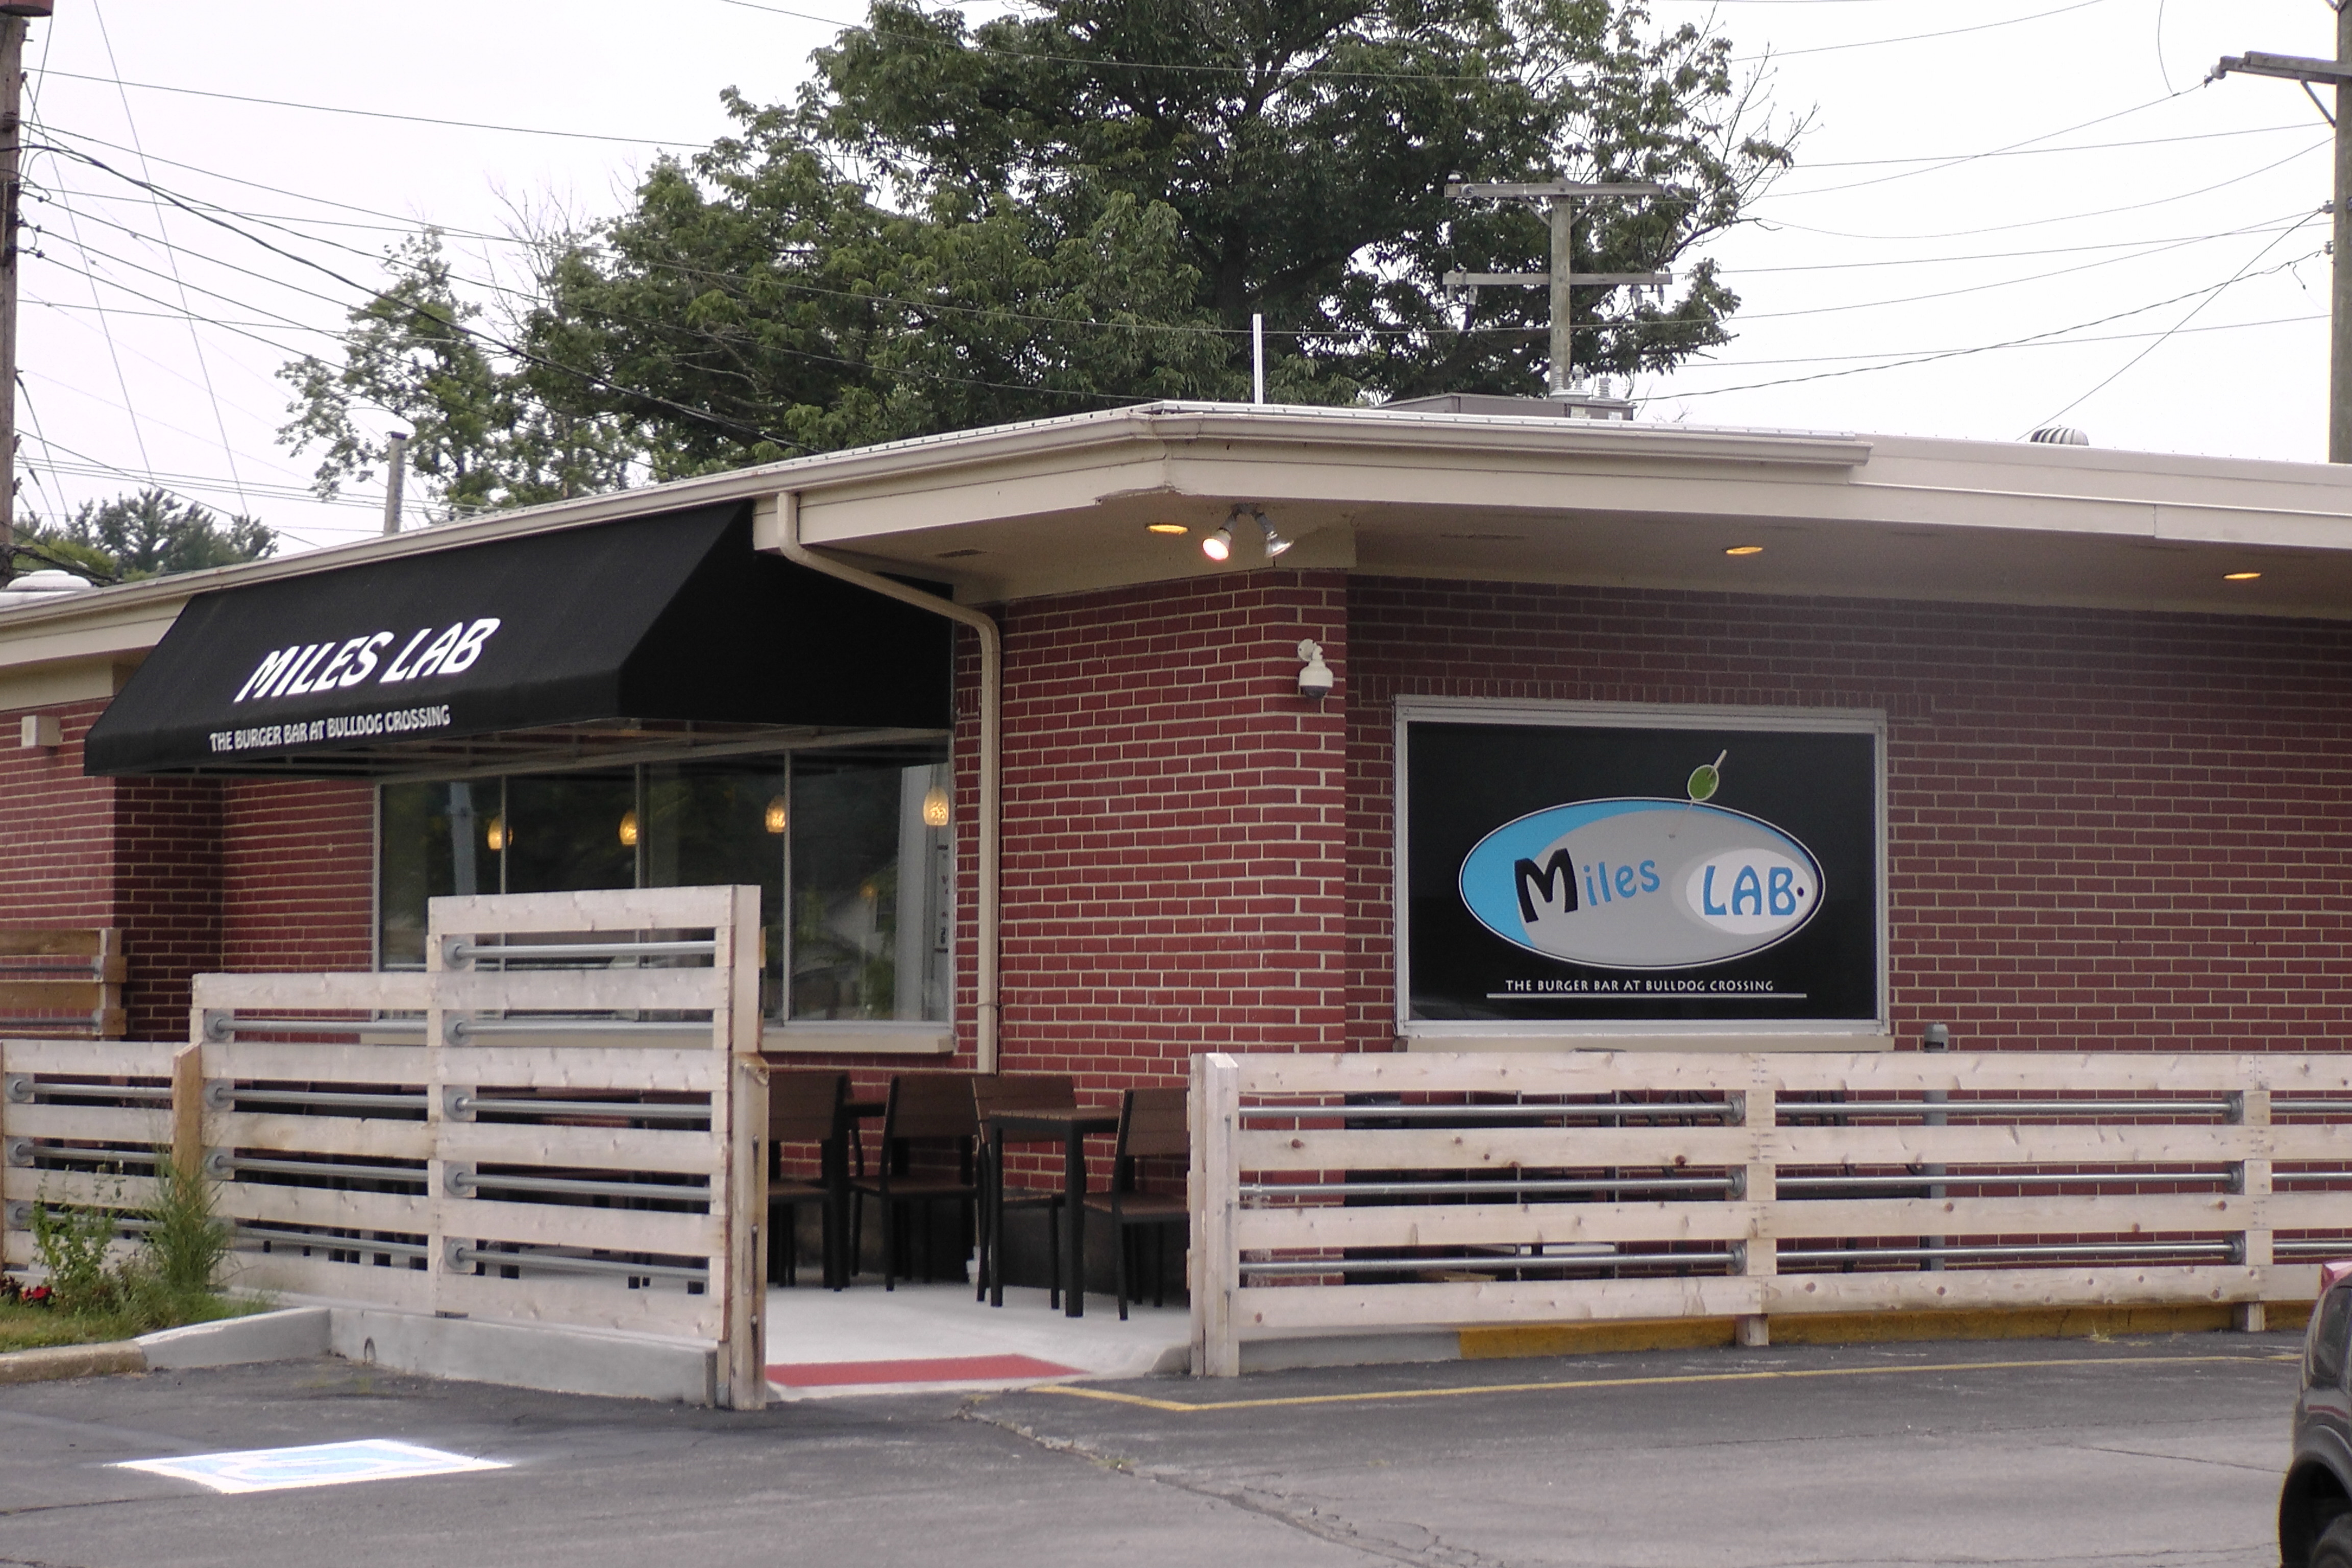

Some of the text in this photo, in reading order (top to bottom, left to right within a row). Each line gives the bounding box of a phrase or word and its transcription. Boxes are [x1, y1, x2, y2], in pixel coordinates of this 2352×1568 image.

[233, 618, 501, 702] MILES LAB
[210, 704, 450, 752] THE BURGER BAR AT BULLDOG CROSSING
[1514, 848, 1661, 923] Miles
[1506, 979, 1774, 992] THE BURGER BAR AT BULLDOG CROSSING
